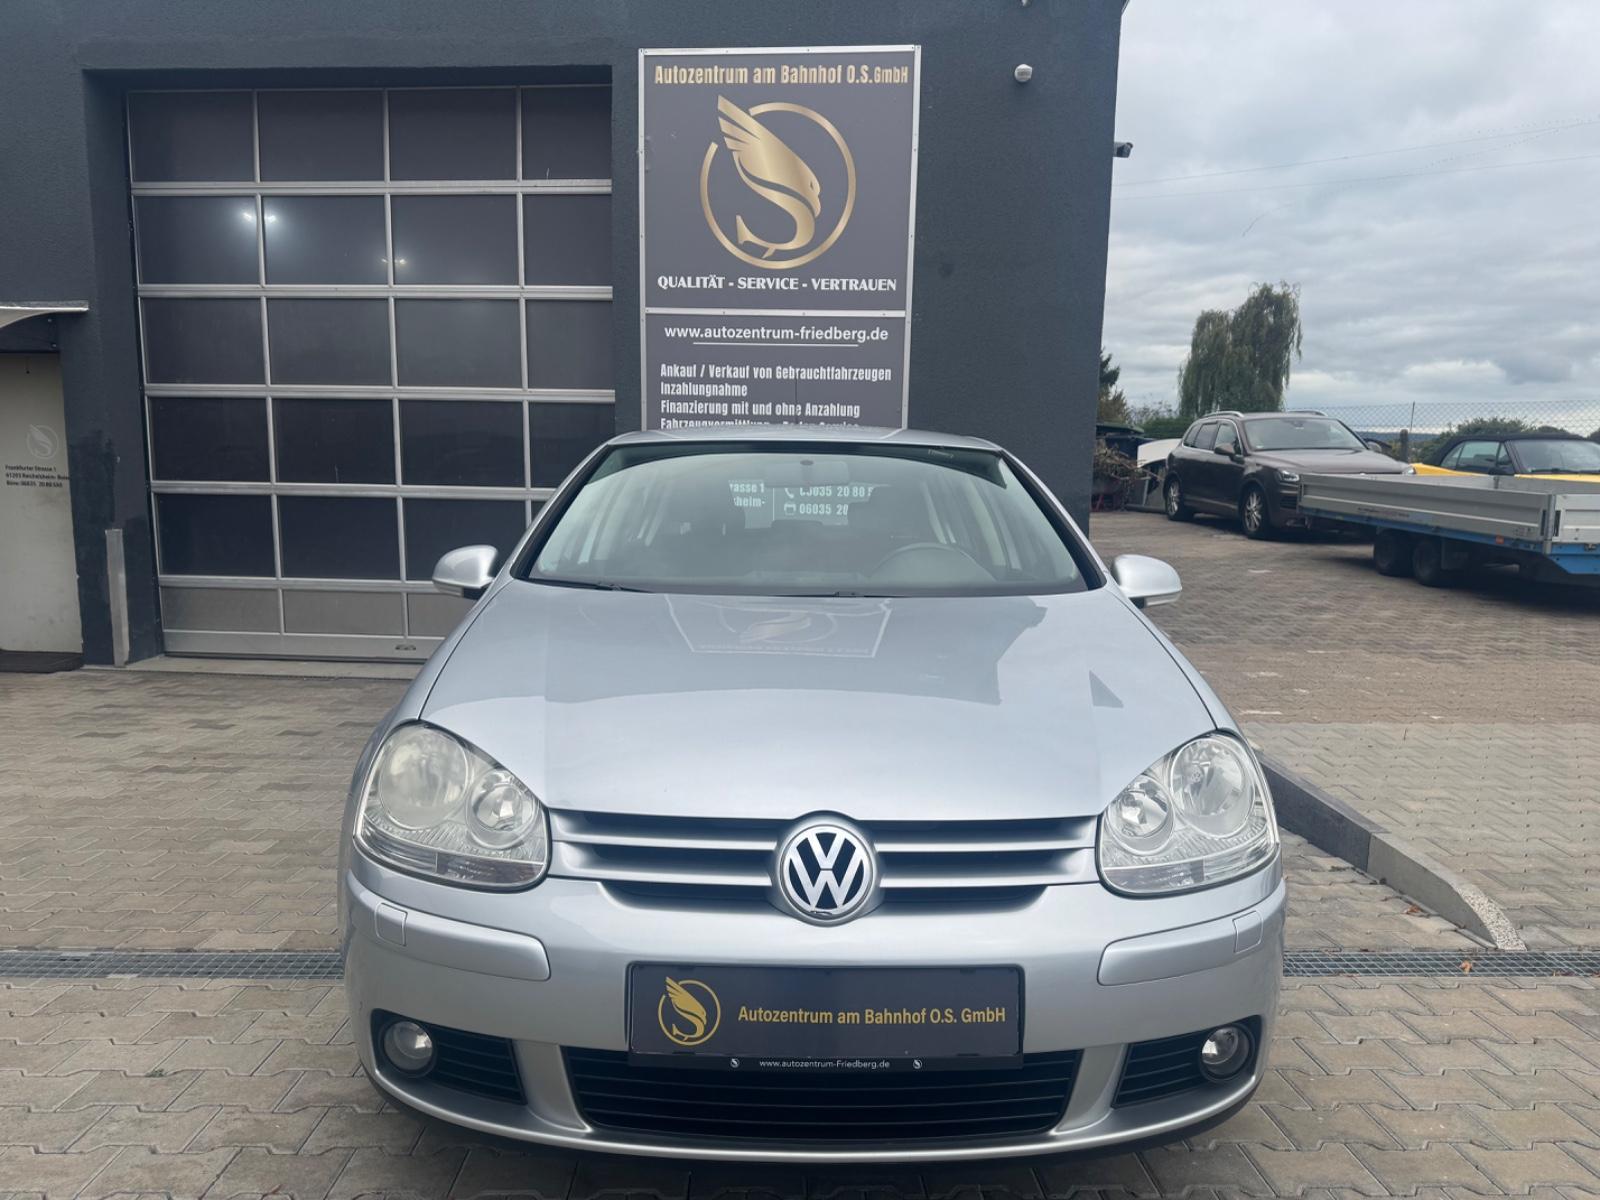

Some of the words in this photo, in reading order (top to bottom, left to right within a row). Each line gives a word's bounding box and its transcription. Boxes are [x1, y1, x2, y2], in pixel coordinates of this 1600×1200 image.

[654, 65, 748, 84] Autozentrum
[753, 66, 776, 84] am
[780, 64, 842, 84] Bahnhof
[657, 275, 725, 290] QUALITÄT
[737, 277, 799, 290] SERVICE
[811, 277, 897, 291] VERTRAUEN
[664, 326, 889, 343] www.autozentrum-friedberg.de
[660, 363, 697, 378] Ankauf
[708, 364, 750, 379] Verkauf
[753, 367, 772, 379] von
[775, 366, 892, 382] Gebrauchtfahrzeugen
[660, 382, 748, 397] Inzahlungnahme
[660, 400, 728, 416] Finanzierung
[731, 401, 749, 415] mit
[752, 402, 772, 415] und
[775, 402, 801, 416] ohne
[805, 403, 860, 418] Anzahlung
[837, 486, 849, 497] 20
[852, 487, 865, 497] 80
[800, 503, 832, 514] 06035
[737, 1006, 834, 1024] Autozentrum
[837, 1010, 861, 1024] am
[864, 1008, 927, 1024] Bahnhof
[929, 1008, 958, 1024] O.S.
[960, 1007, 1007, 1023] GmbH
[759, 1058, 891, 1070] www.autozentrum-Friedberg.de
